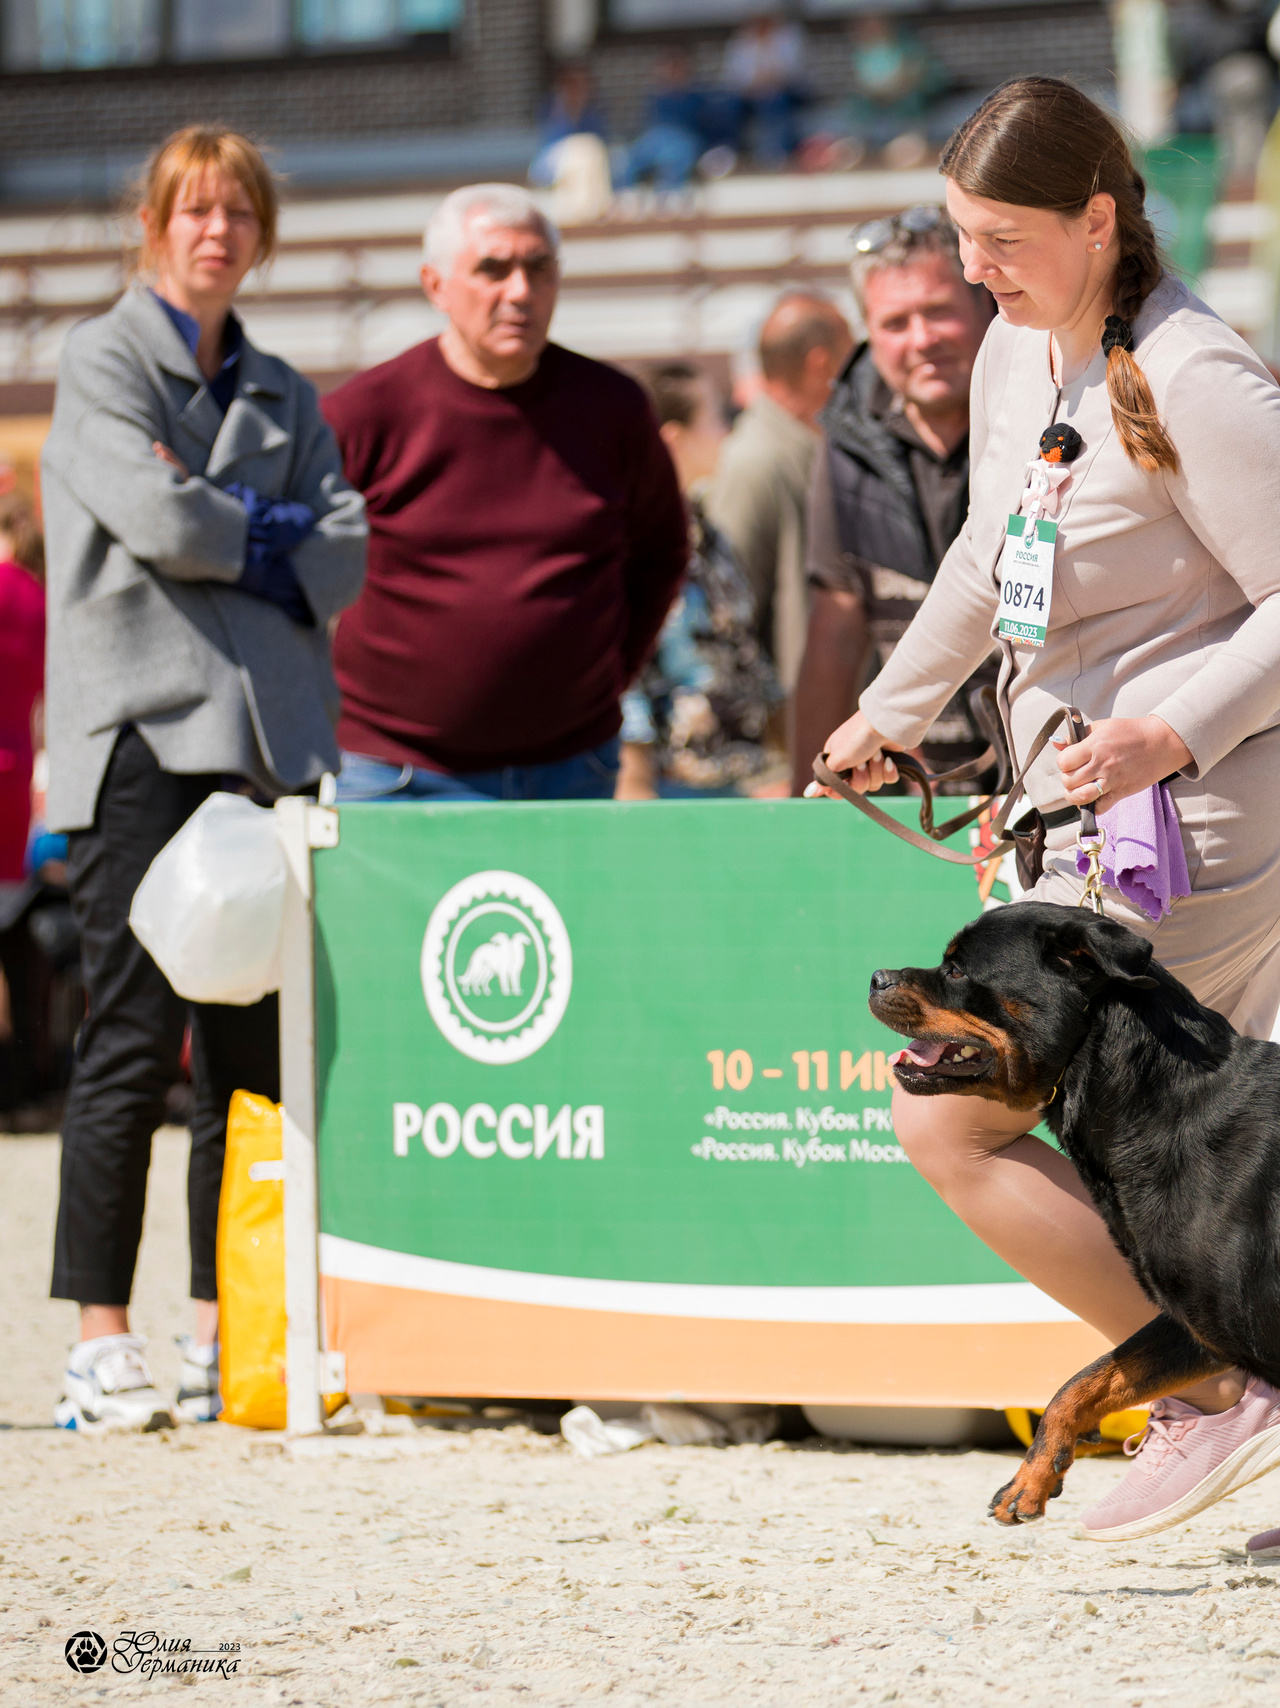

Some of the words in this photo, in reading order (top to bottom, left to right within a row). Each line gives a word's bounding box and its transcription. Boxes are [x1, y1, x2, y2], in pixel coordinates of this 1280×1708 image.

[1015, 550, 1038, 562] РОССИЯ
[1004, 580, 1045, 612] 0874
[1004, 621, 1038, 638] 11.06.2023
[706, 1049, 753, 1091] 10
[792, 1050, 829, 1091] 11
[393, 1102, 605, 1160] РОССИЯ
[796, 1105, 860, 1137] Кубок
[863, 1107, 894, 1132] РК
[782, 1136, 847, 1168] Кубок
[849, 1138, 912, 1163] Моск
